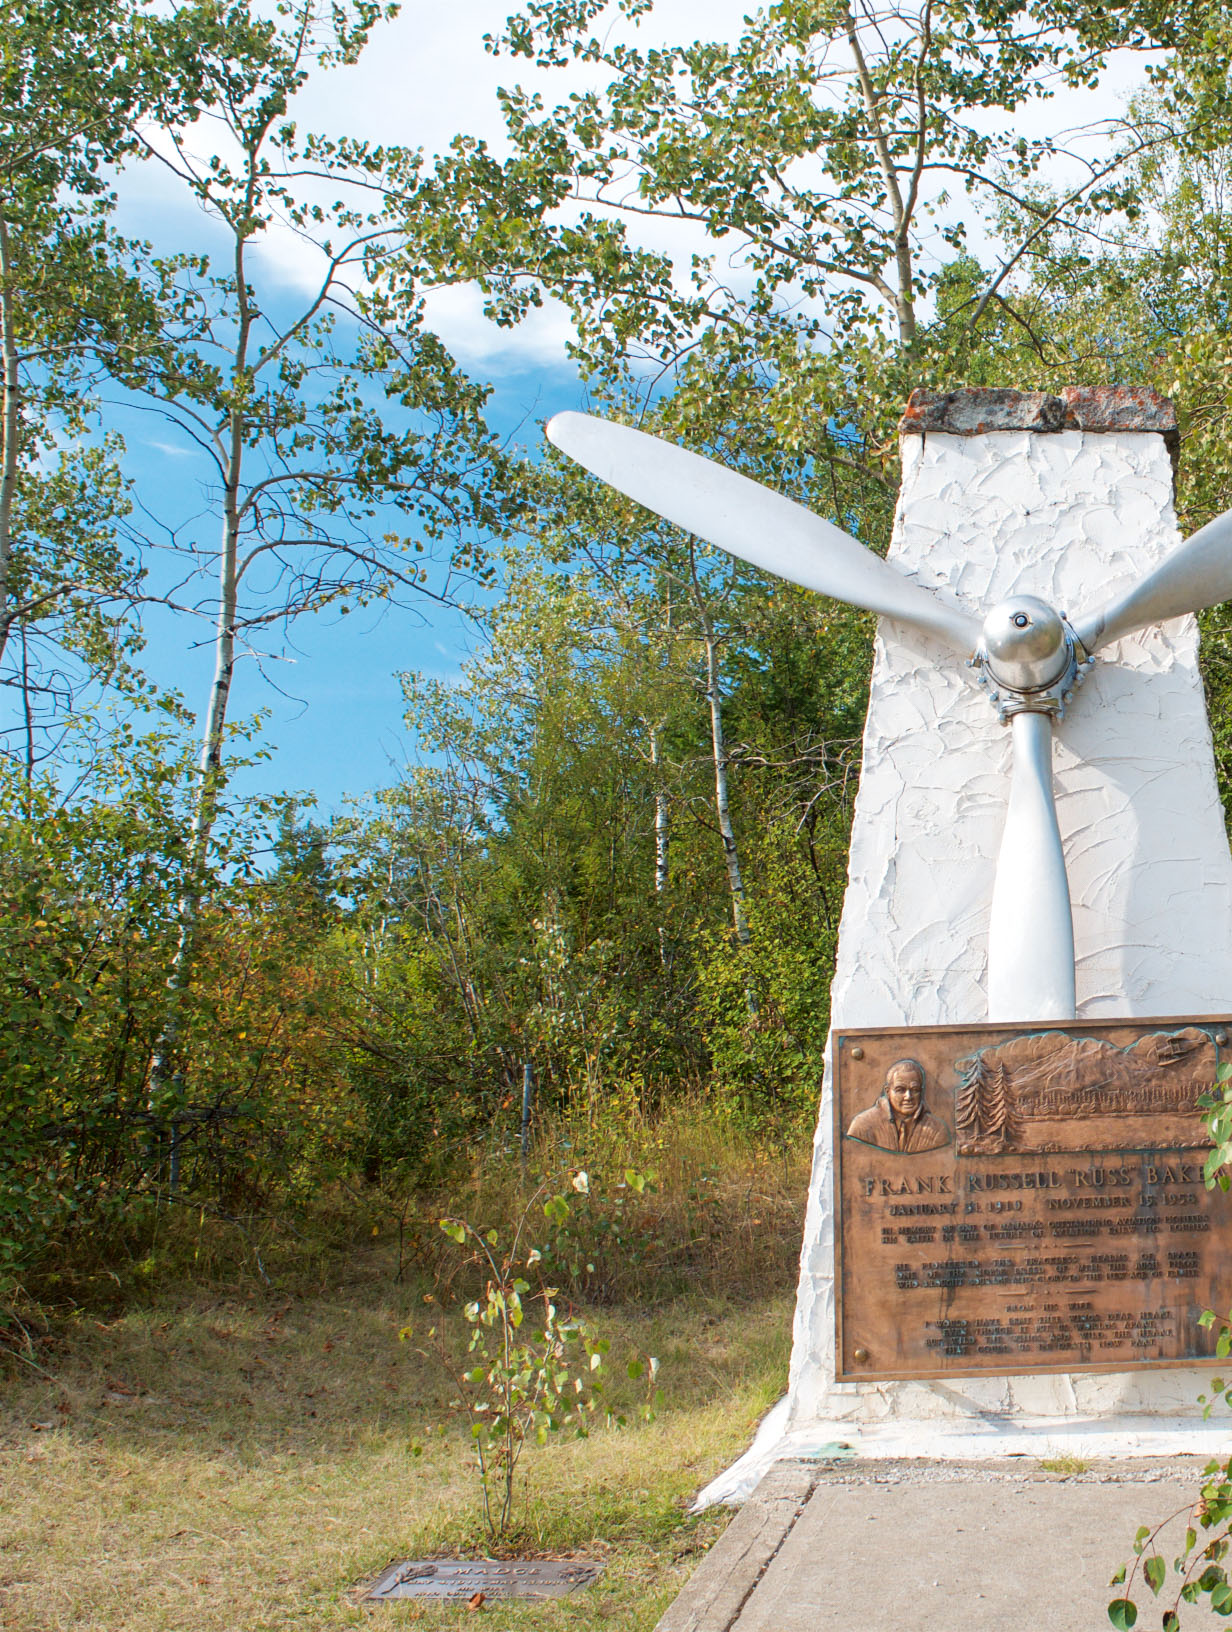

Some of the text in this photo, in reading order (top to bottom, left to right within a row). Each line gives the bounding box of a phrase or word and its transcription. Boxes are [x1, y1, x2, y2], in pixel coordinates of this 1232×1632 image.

[864, 1164, 1227, 1197] FRANK RUSSELL "RUSS" BAKE
[889, 1202, 958, 1216] JANUARY
[988, 1200, 1023, 1213] 1910
[1049, 1195, 1131, 1209] NOVEMBER
[452, 1567, 541, 1576] MADGE
